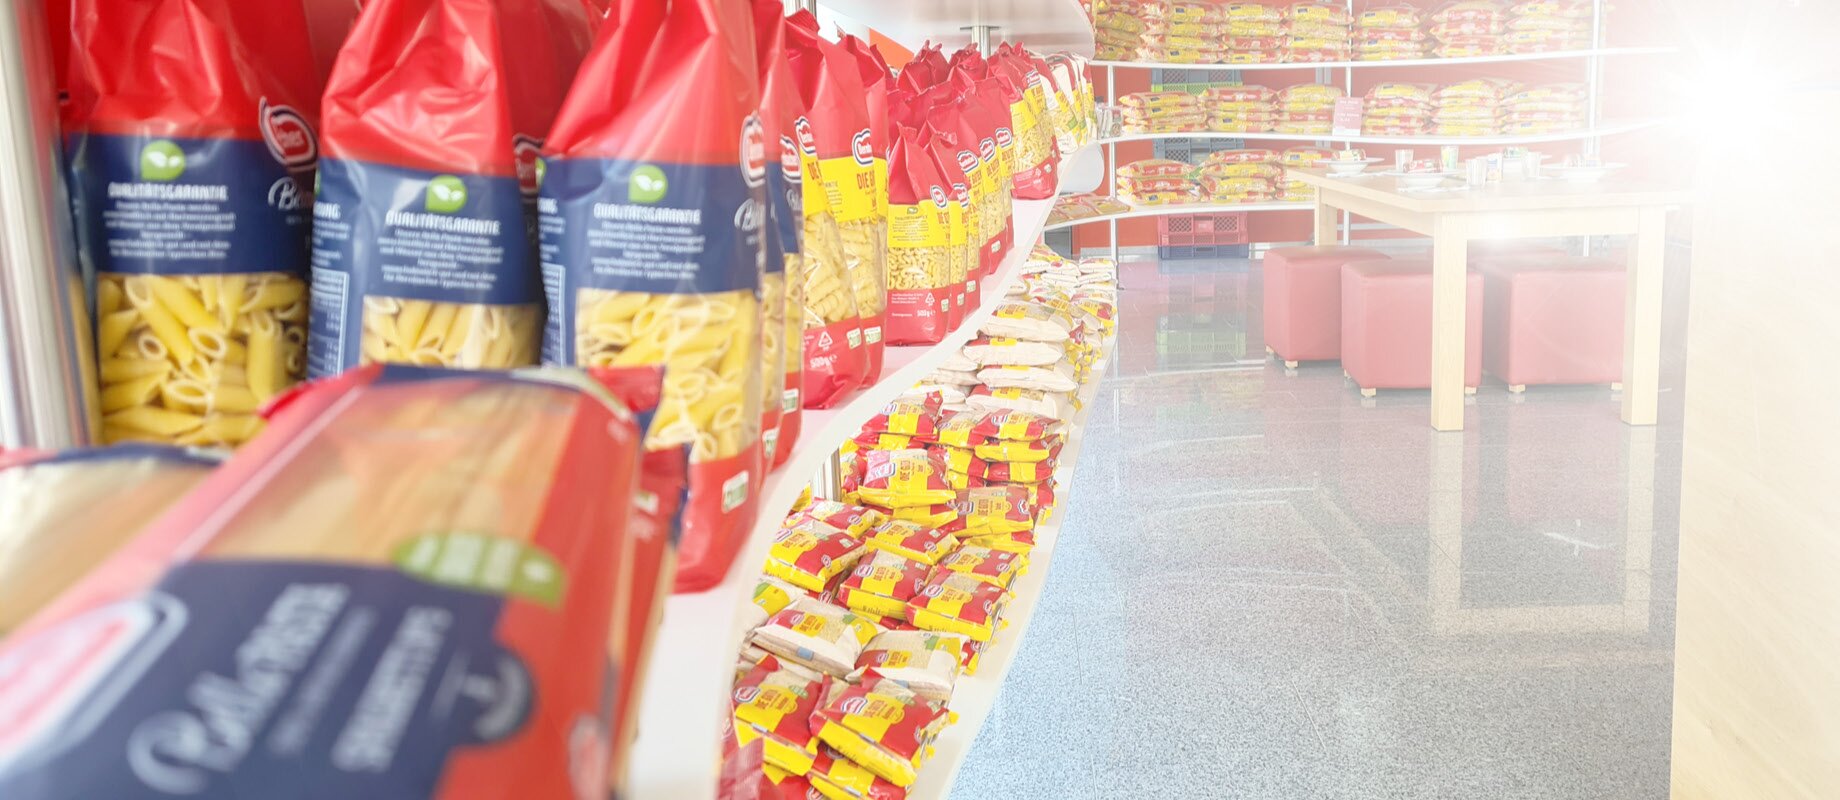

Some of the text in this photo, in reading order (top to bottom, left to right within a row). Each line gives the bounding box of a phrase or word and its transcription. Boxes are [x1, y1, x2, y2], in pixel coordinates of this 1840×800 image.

[857, 171, 870, 190] DIE
[386, 209, 500, 234] QUALITÄTSGARANTIE
[593, 202, 702, 225] QUALITÄTSGARANTIE
